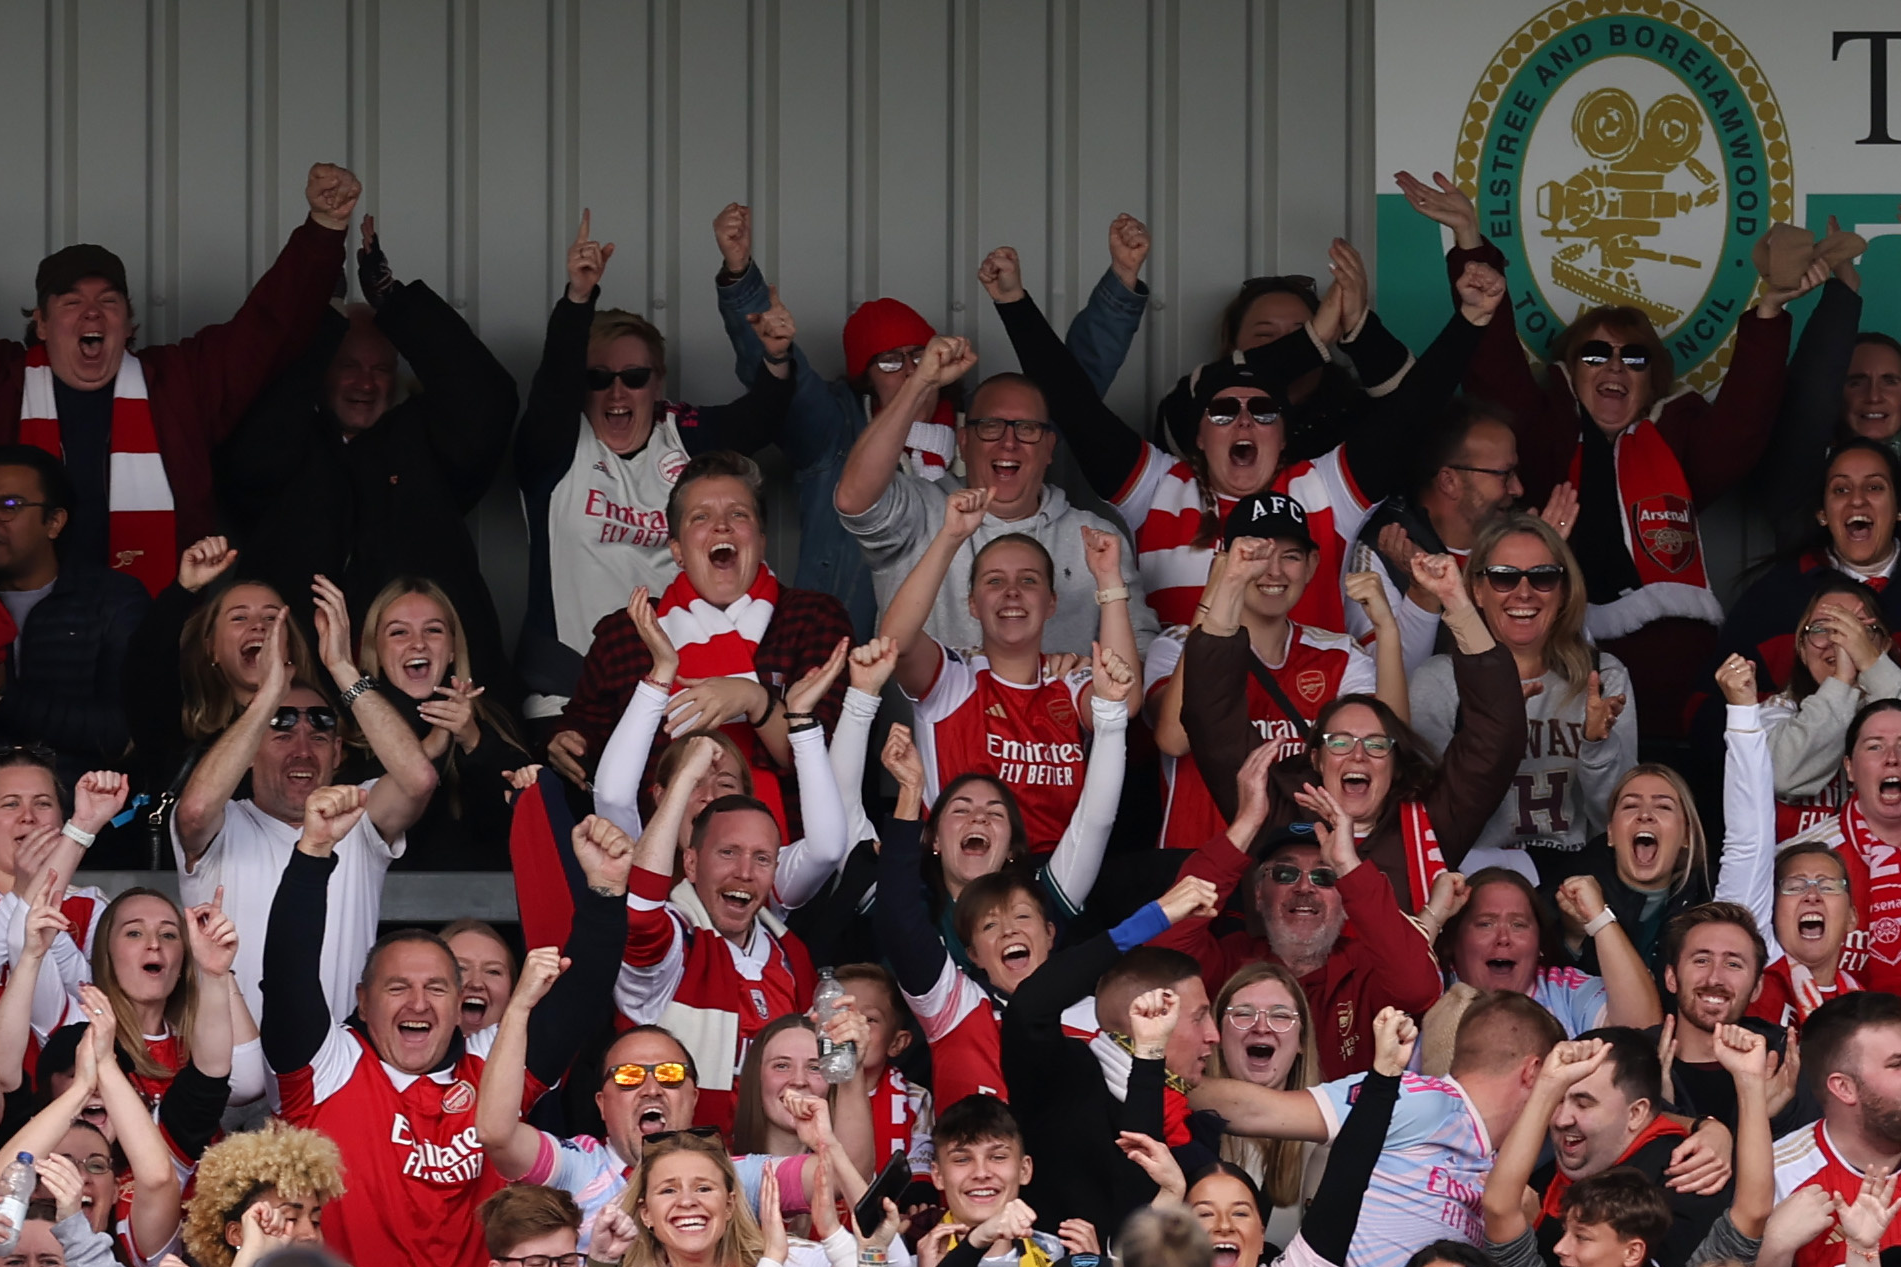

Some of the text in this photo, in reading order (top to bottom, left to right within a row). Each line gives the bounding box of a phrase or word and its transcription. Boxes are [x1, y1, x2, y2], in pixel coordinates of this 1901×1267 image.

[1490, 23, 1759, 238] ELSTREE AND BOREHAMWOOD
[585, 489, 667, 530] Emira
[1251, 497, 1303, 523] AFC
[1639, 509, 1689, 524] Arsenal
[599, 523, 630, 544] FLY
[986, 732, 1084, 764] Emirates
[998, 763, 1074, 787] FLY BETTER
